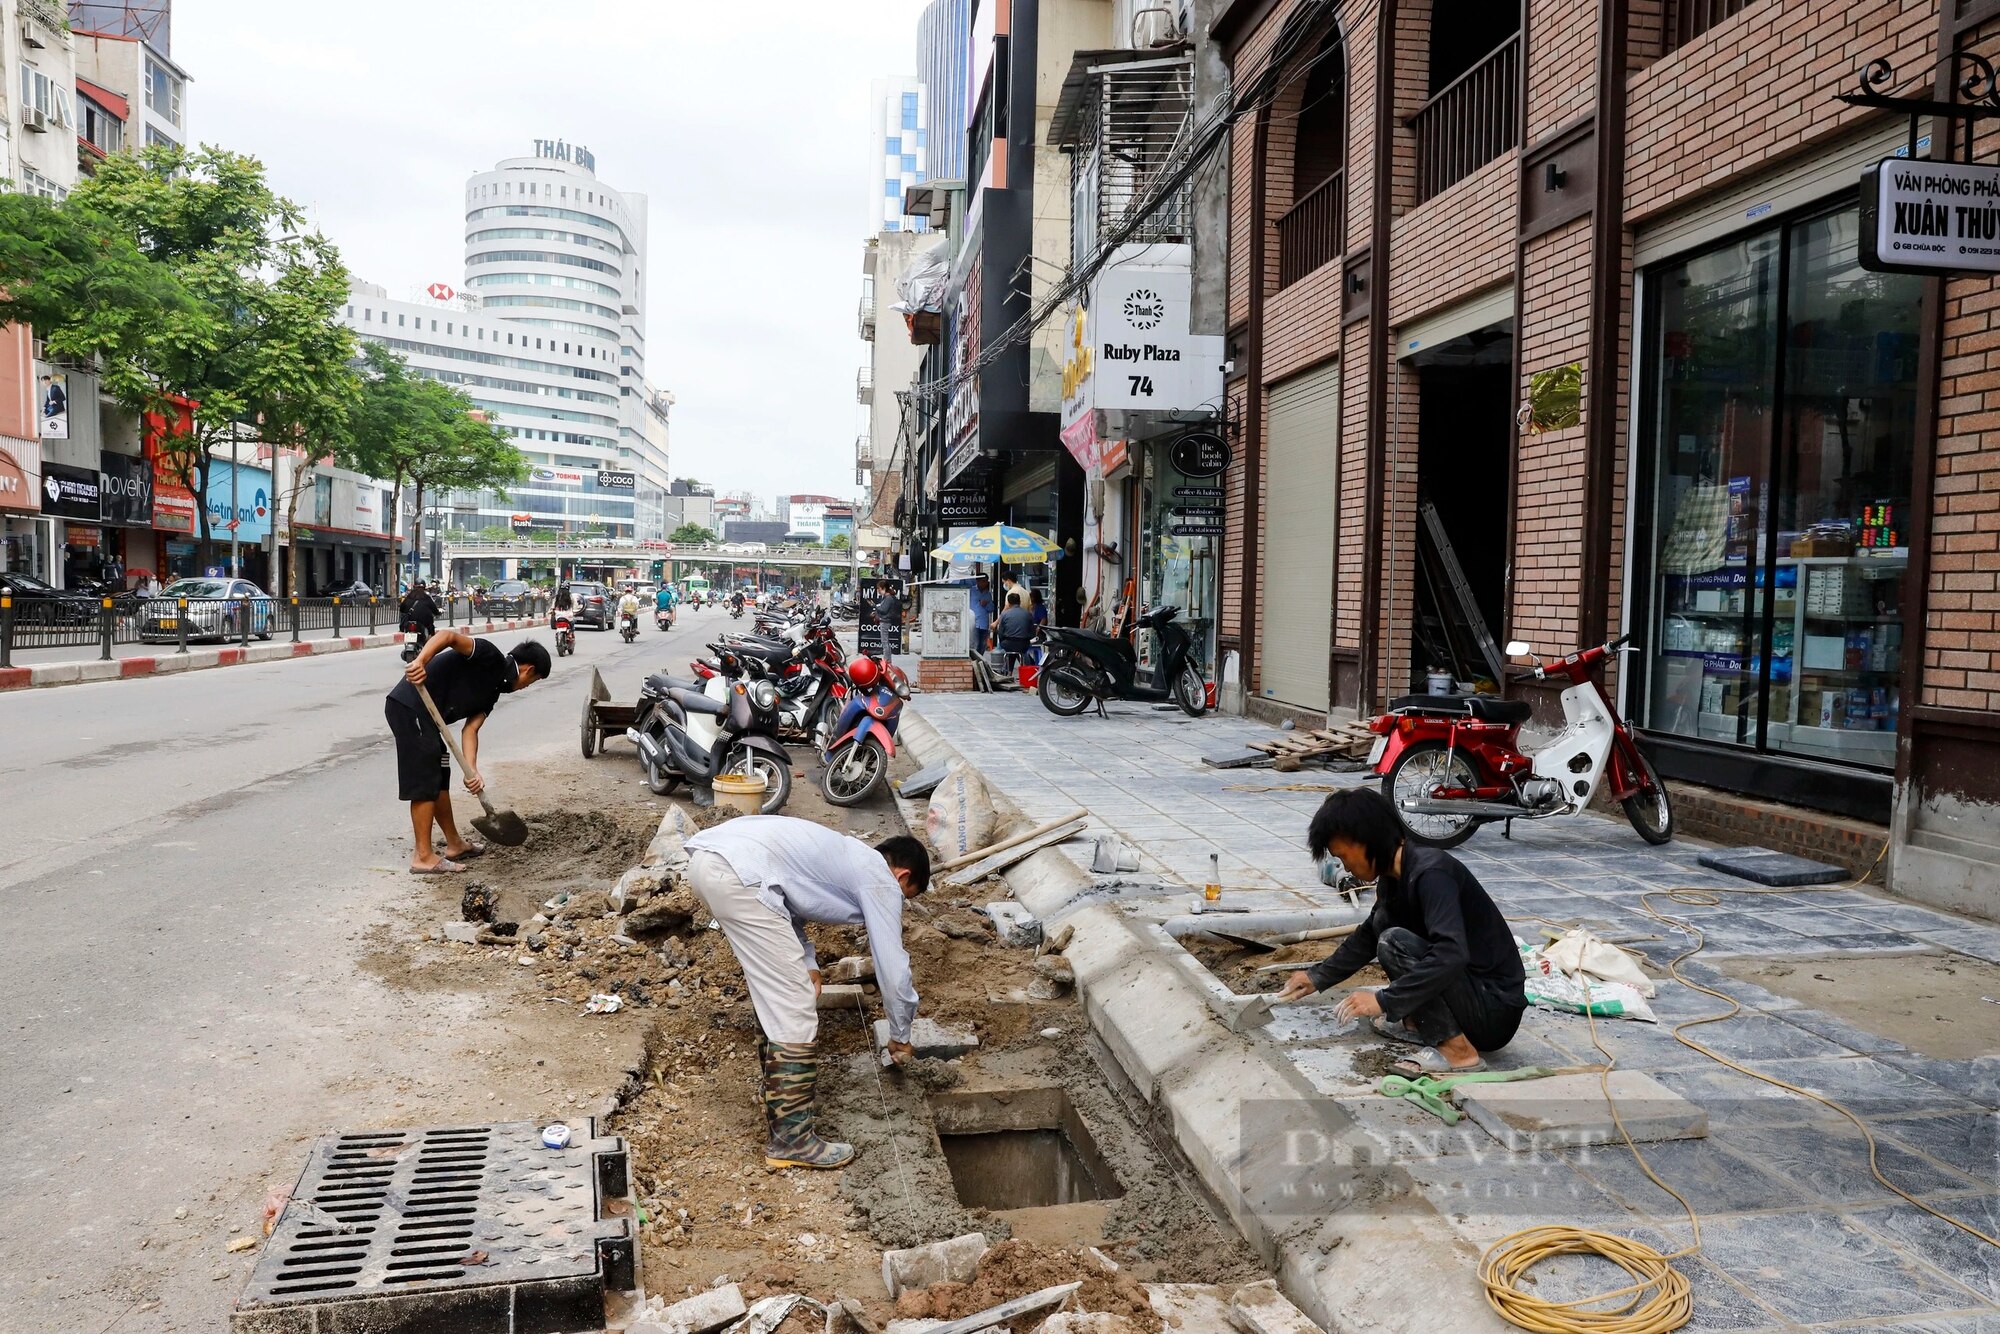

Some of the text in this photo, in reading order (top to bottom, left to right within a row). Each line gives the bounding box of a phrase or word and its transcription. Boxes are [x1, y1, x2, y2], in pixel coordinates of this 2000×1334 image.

[534, 138, 570, 162] THÁI
[1895, 171, 1921, 192] VĂN
[1925, 174, 1970, 195] PHÒNG
[1894, 198, 1948, 237] XUÂN
[1913, 242, 1931, 251] CHÙA
[1932, 245, 1946, 253] BỘC
[456, 292, 478, 303] HSBC
[1135, 304, 1153, 316] Thanh
[1104, 343, 1180, 363] Ruby Plaza
[1128, 375, 1153, 396] 74
[1201, 443, 1214, 451] the
[1201, 451, 1222, 459] book
[556, 472, 581, 481] TOSHIBA
[612, 476, 634, 485] COCO
[100, 473, 151, 506] novelty
[944, 493, 986, 504] MỸ PHẨM
[941, 506, 988, 515] COCOLUX
[514, 519, 532, 527] sushi
[862, 586, 876, 599] MỸ
[956, 776, 965, 796] LONG
